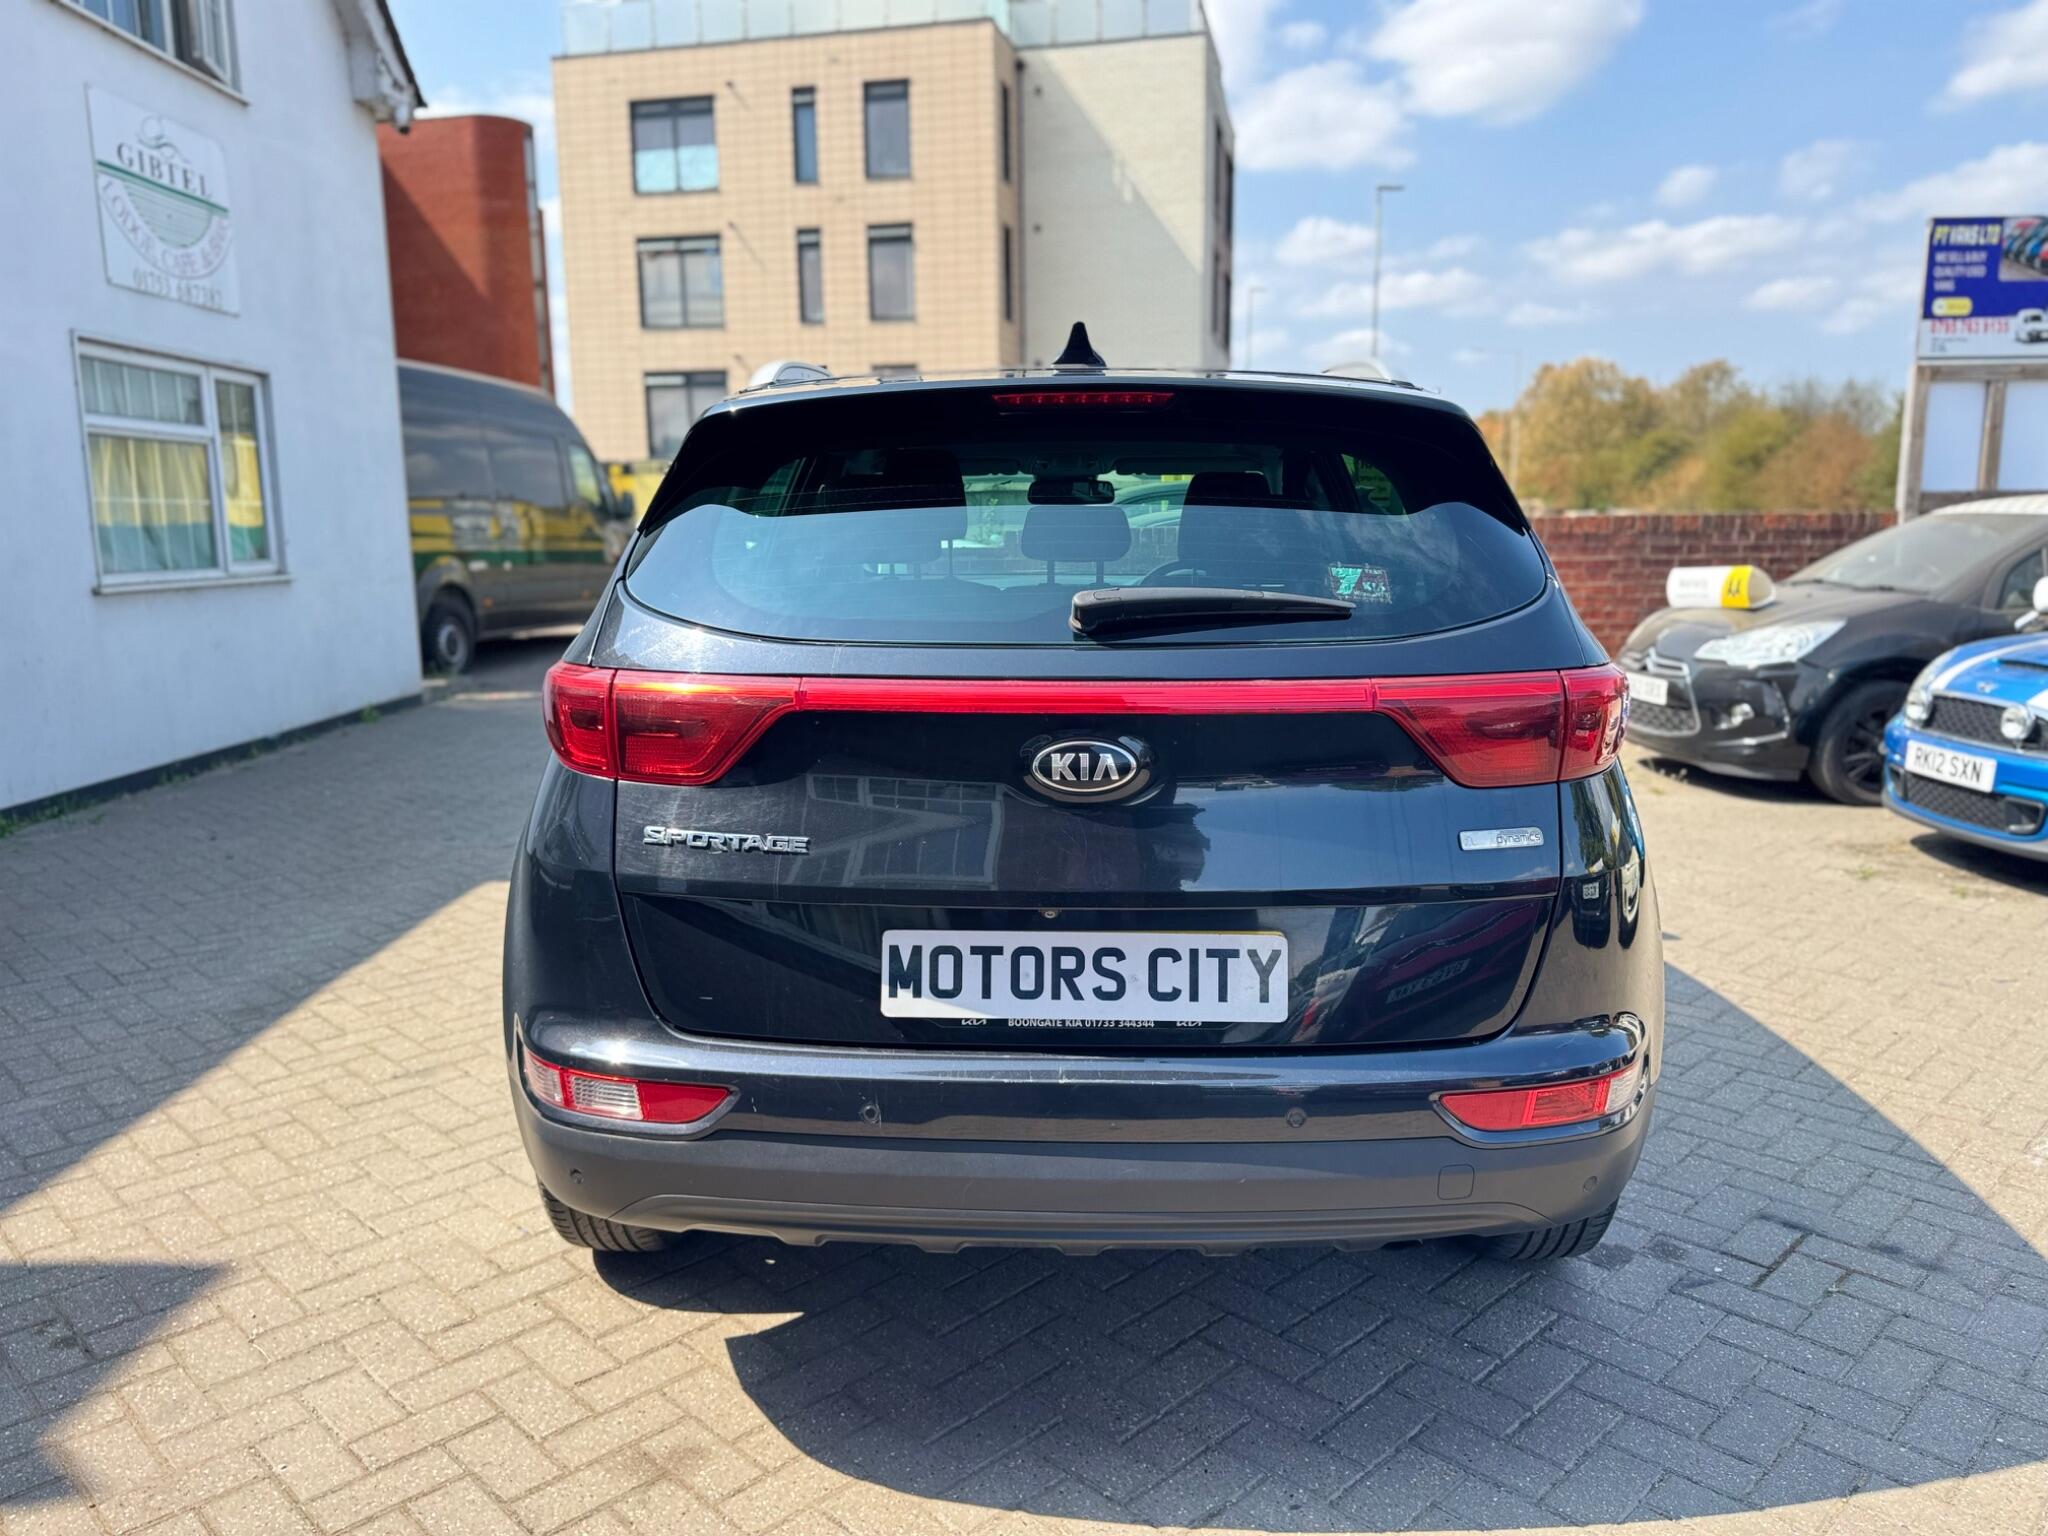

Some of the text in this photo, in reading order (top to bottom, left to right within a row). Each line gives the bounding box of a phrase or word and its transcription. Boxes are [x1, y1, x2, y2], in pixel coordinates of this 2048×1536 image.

[117, 142, 212, 198] GIBTEL
[1050, 752, 1120, 781] KIA
[1914, 747, 1983, 783] RK12 SXN
[643, 825, 811, 853] SPORTAGE
[888, 944, 1282, 1004] MOTORS CITY
[1007, 1018, 1062, 1027] BOONGATE
[1065, 1018, 1083, 1027] KIA
